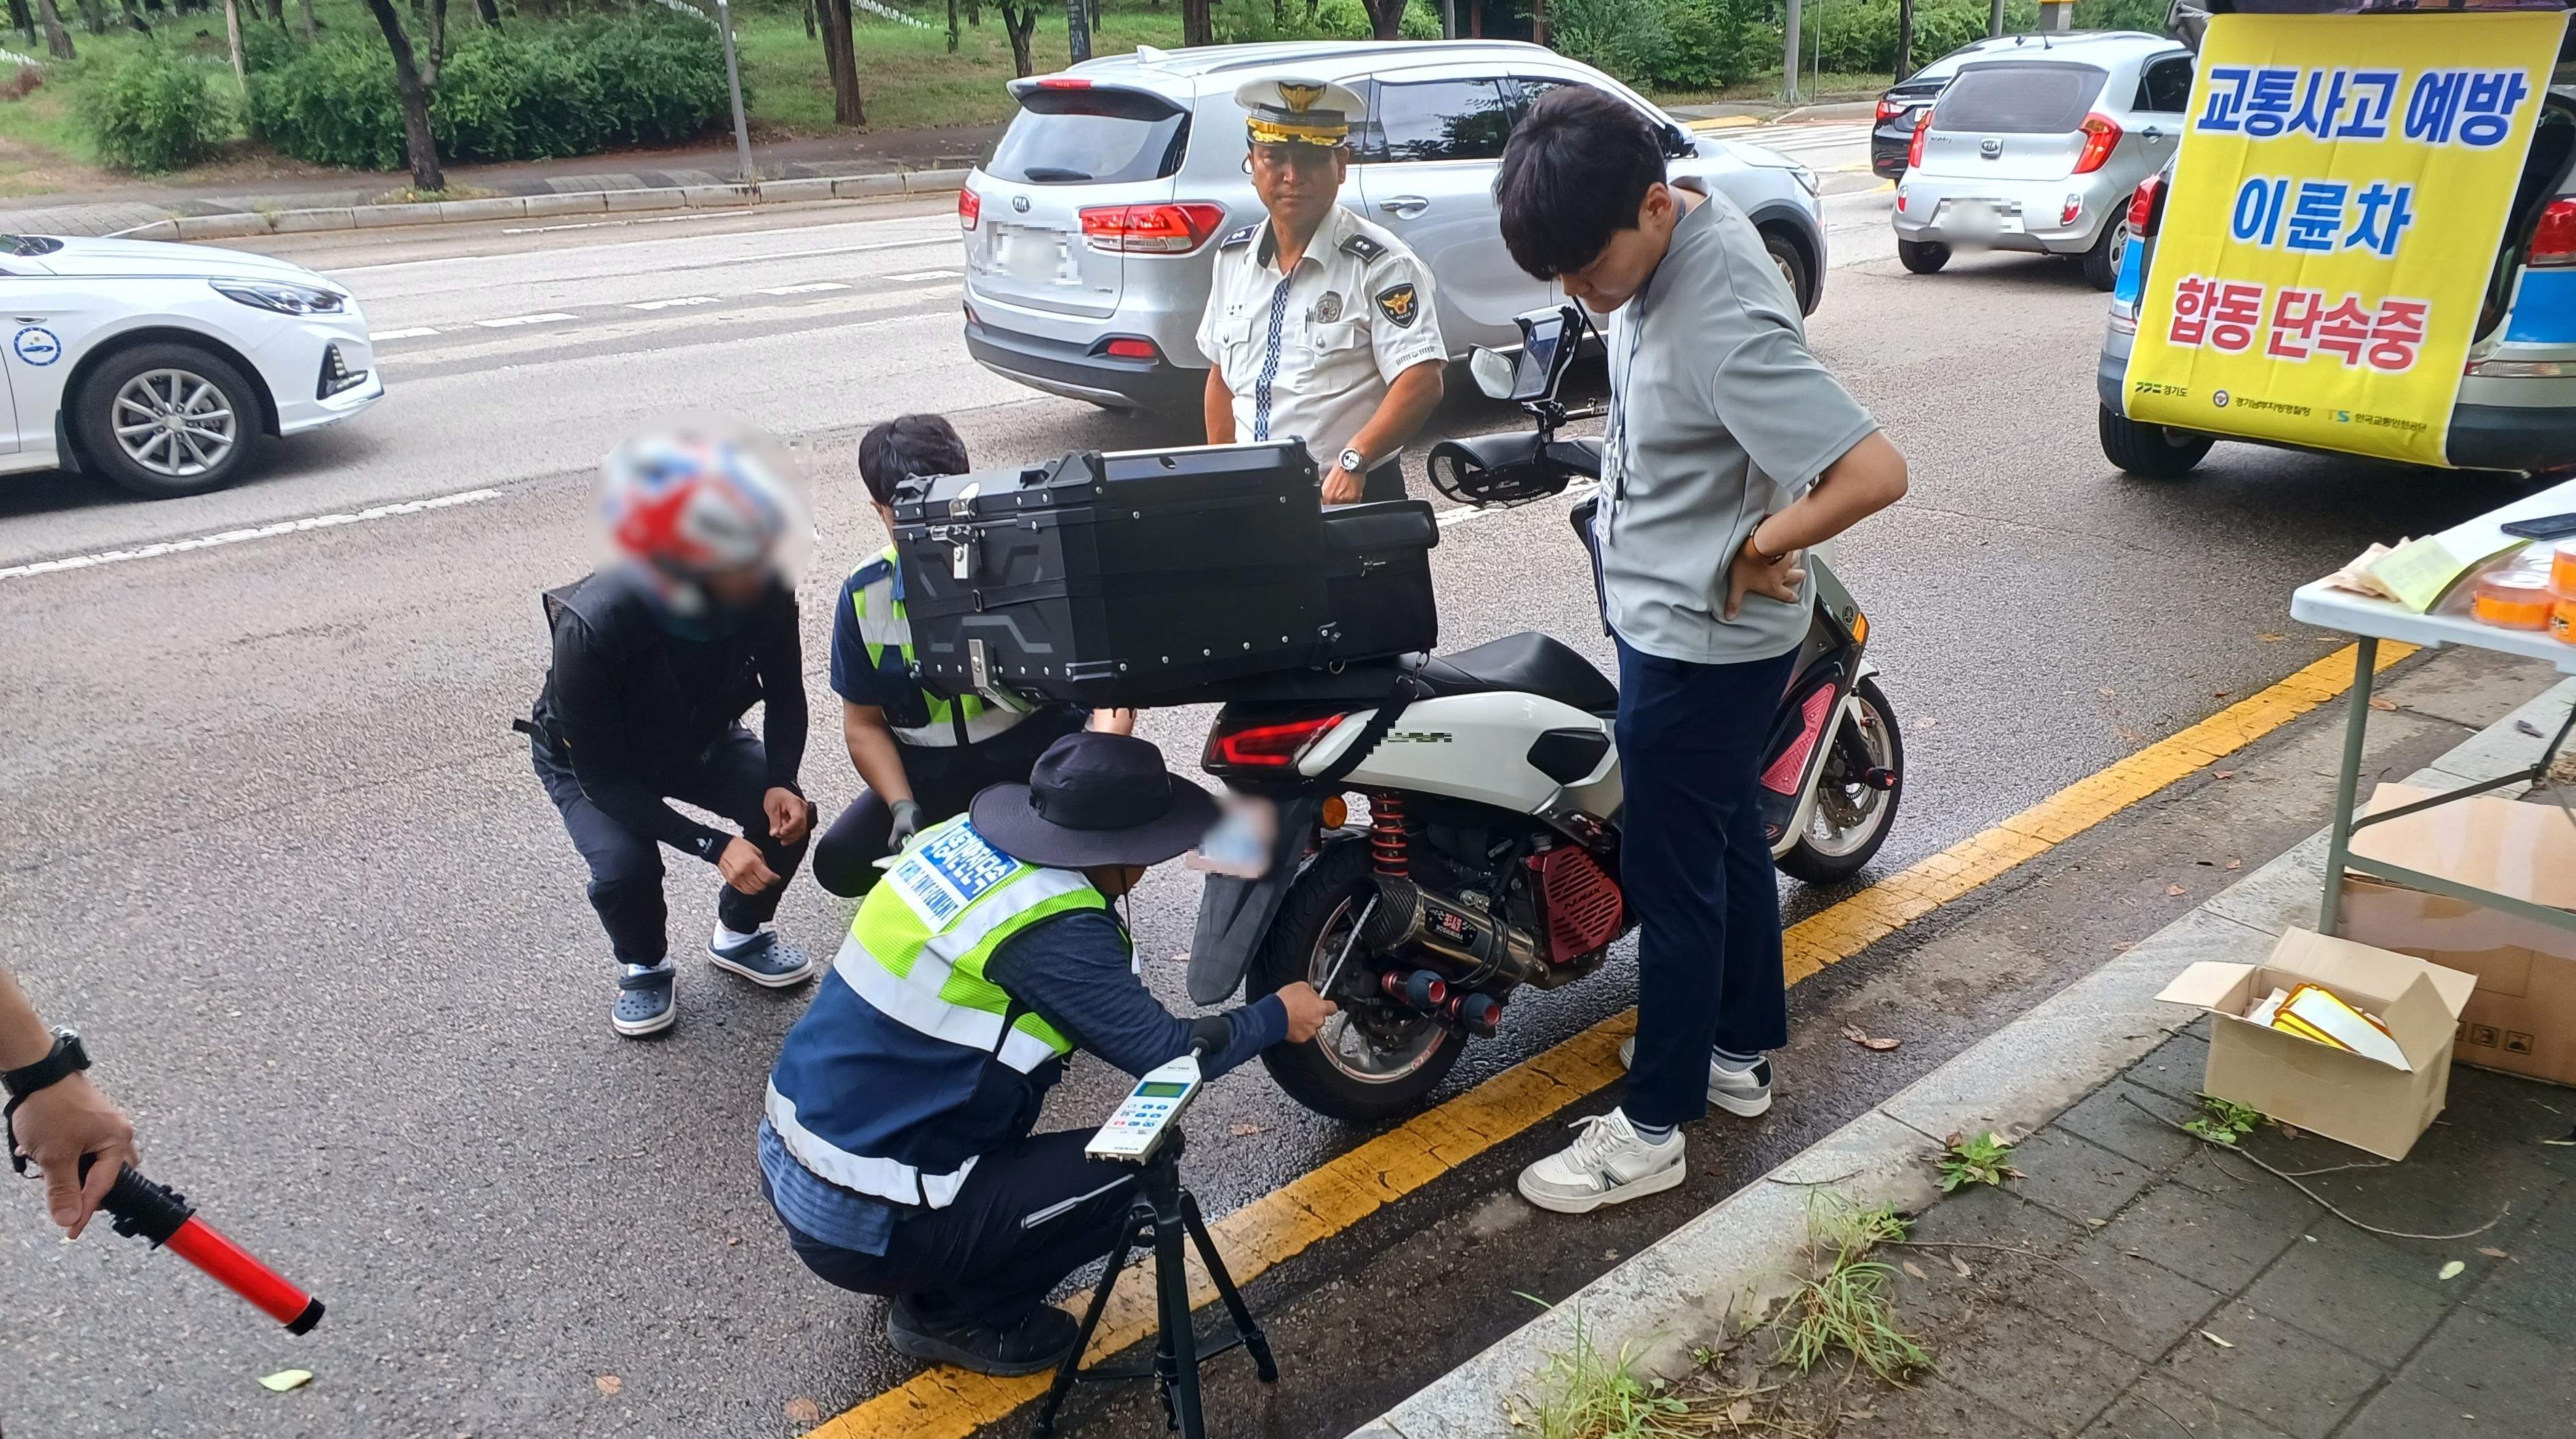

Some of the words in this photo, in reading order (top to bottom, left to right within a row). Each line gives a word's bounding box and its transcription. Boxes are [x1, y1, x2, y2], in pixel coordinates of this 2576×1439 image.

[2196, 67, 2400, 139] 교통사고
[2404, 71, 2528, 146] 예방
[1982, 140, 1999, 151] KIA
[1013, 197, 1028, 211] KIA
[2232, 178, 2413, 256] 이륜차
[2168, 277, 2263, 351] 합동
[2267, 291, 2428, 371] 단속중
[2163, 385, 2188, 397] 경기도
[2325, 408, 2350, 423] TS
